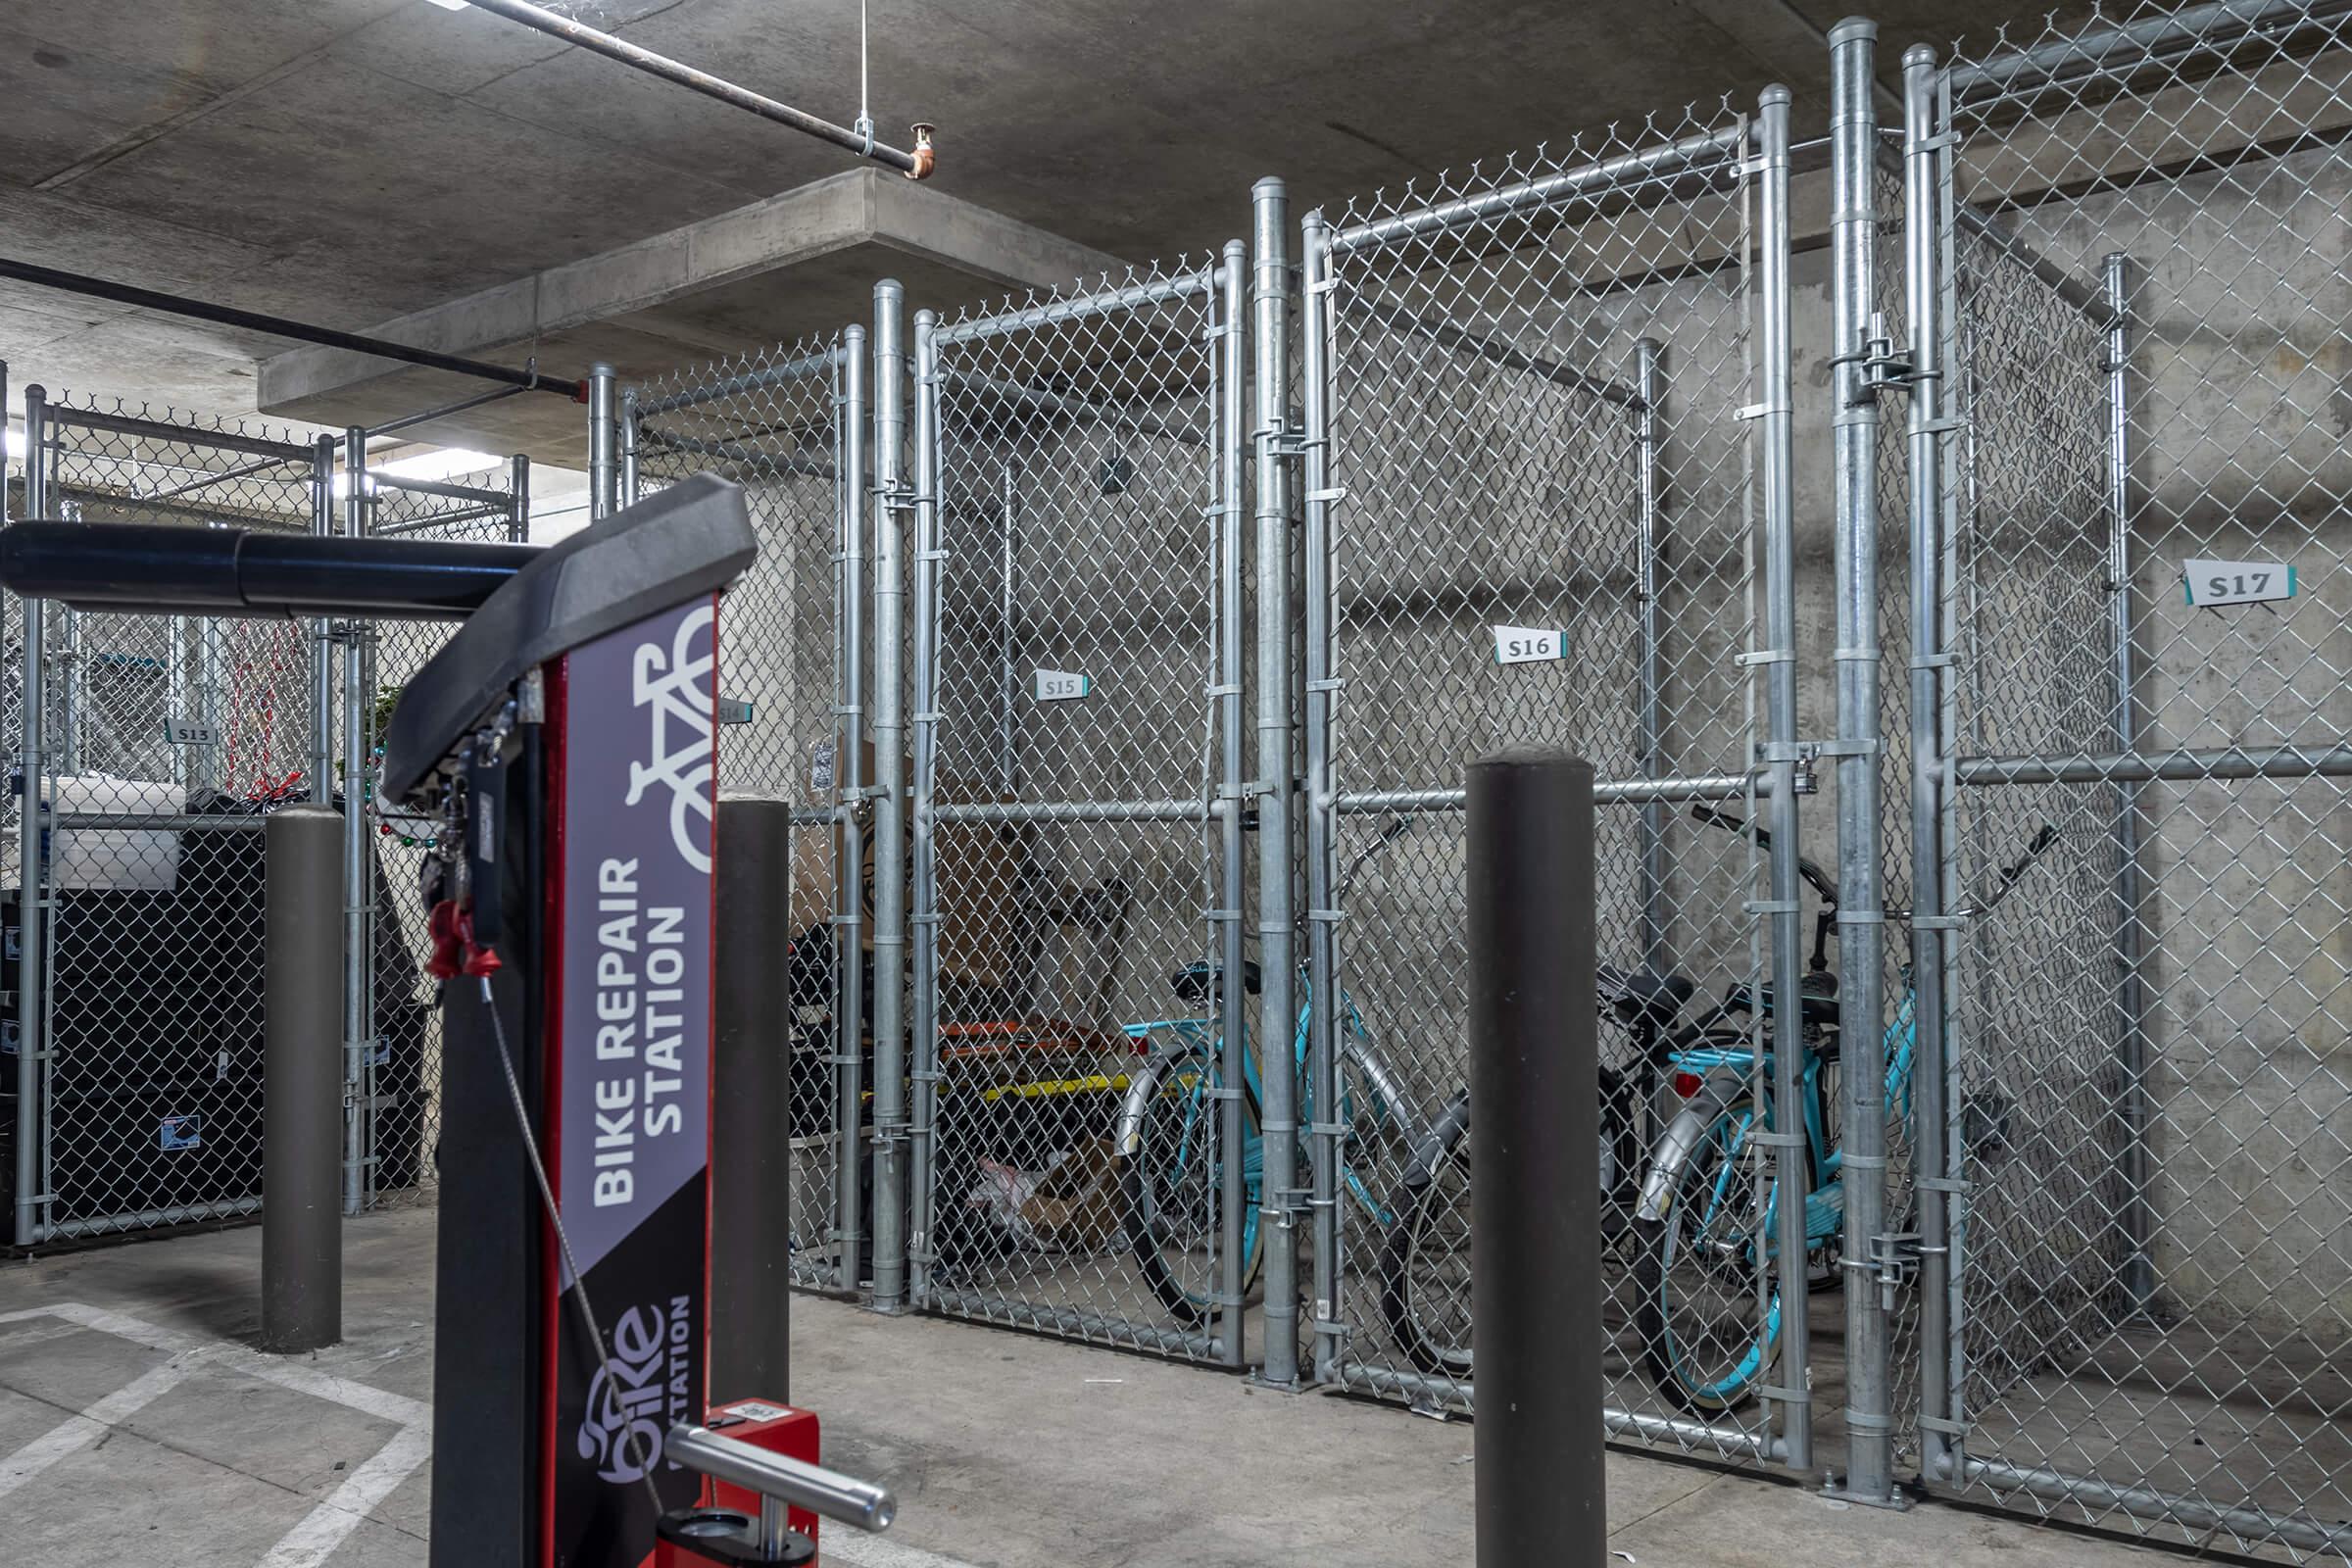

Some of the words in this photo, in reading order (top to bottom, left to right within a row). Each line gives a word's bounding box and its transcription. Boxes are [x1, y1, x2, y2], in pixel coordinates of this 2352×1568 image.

[2208, 572, 2273, 598] S17
[1508, 637, 1549, 658] S16
[1045, 679, 1075, 696] S15
[178, 728, 209, 741] S13
[596, 858, 639, 1061] REPAIR
[644, 906, 685, 1138] STATION
[594, 1077, 636, 1207] BIKE
[668, 1295, 690, 1471] TATION
